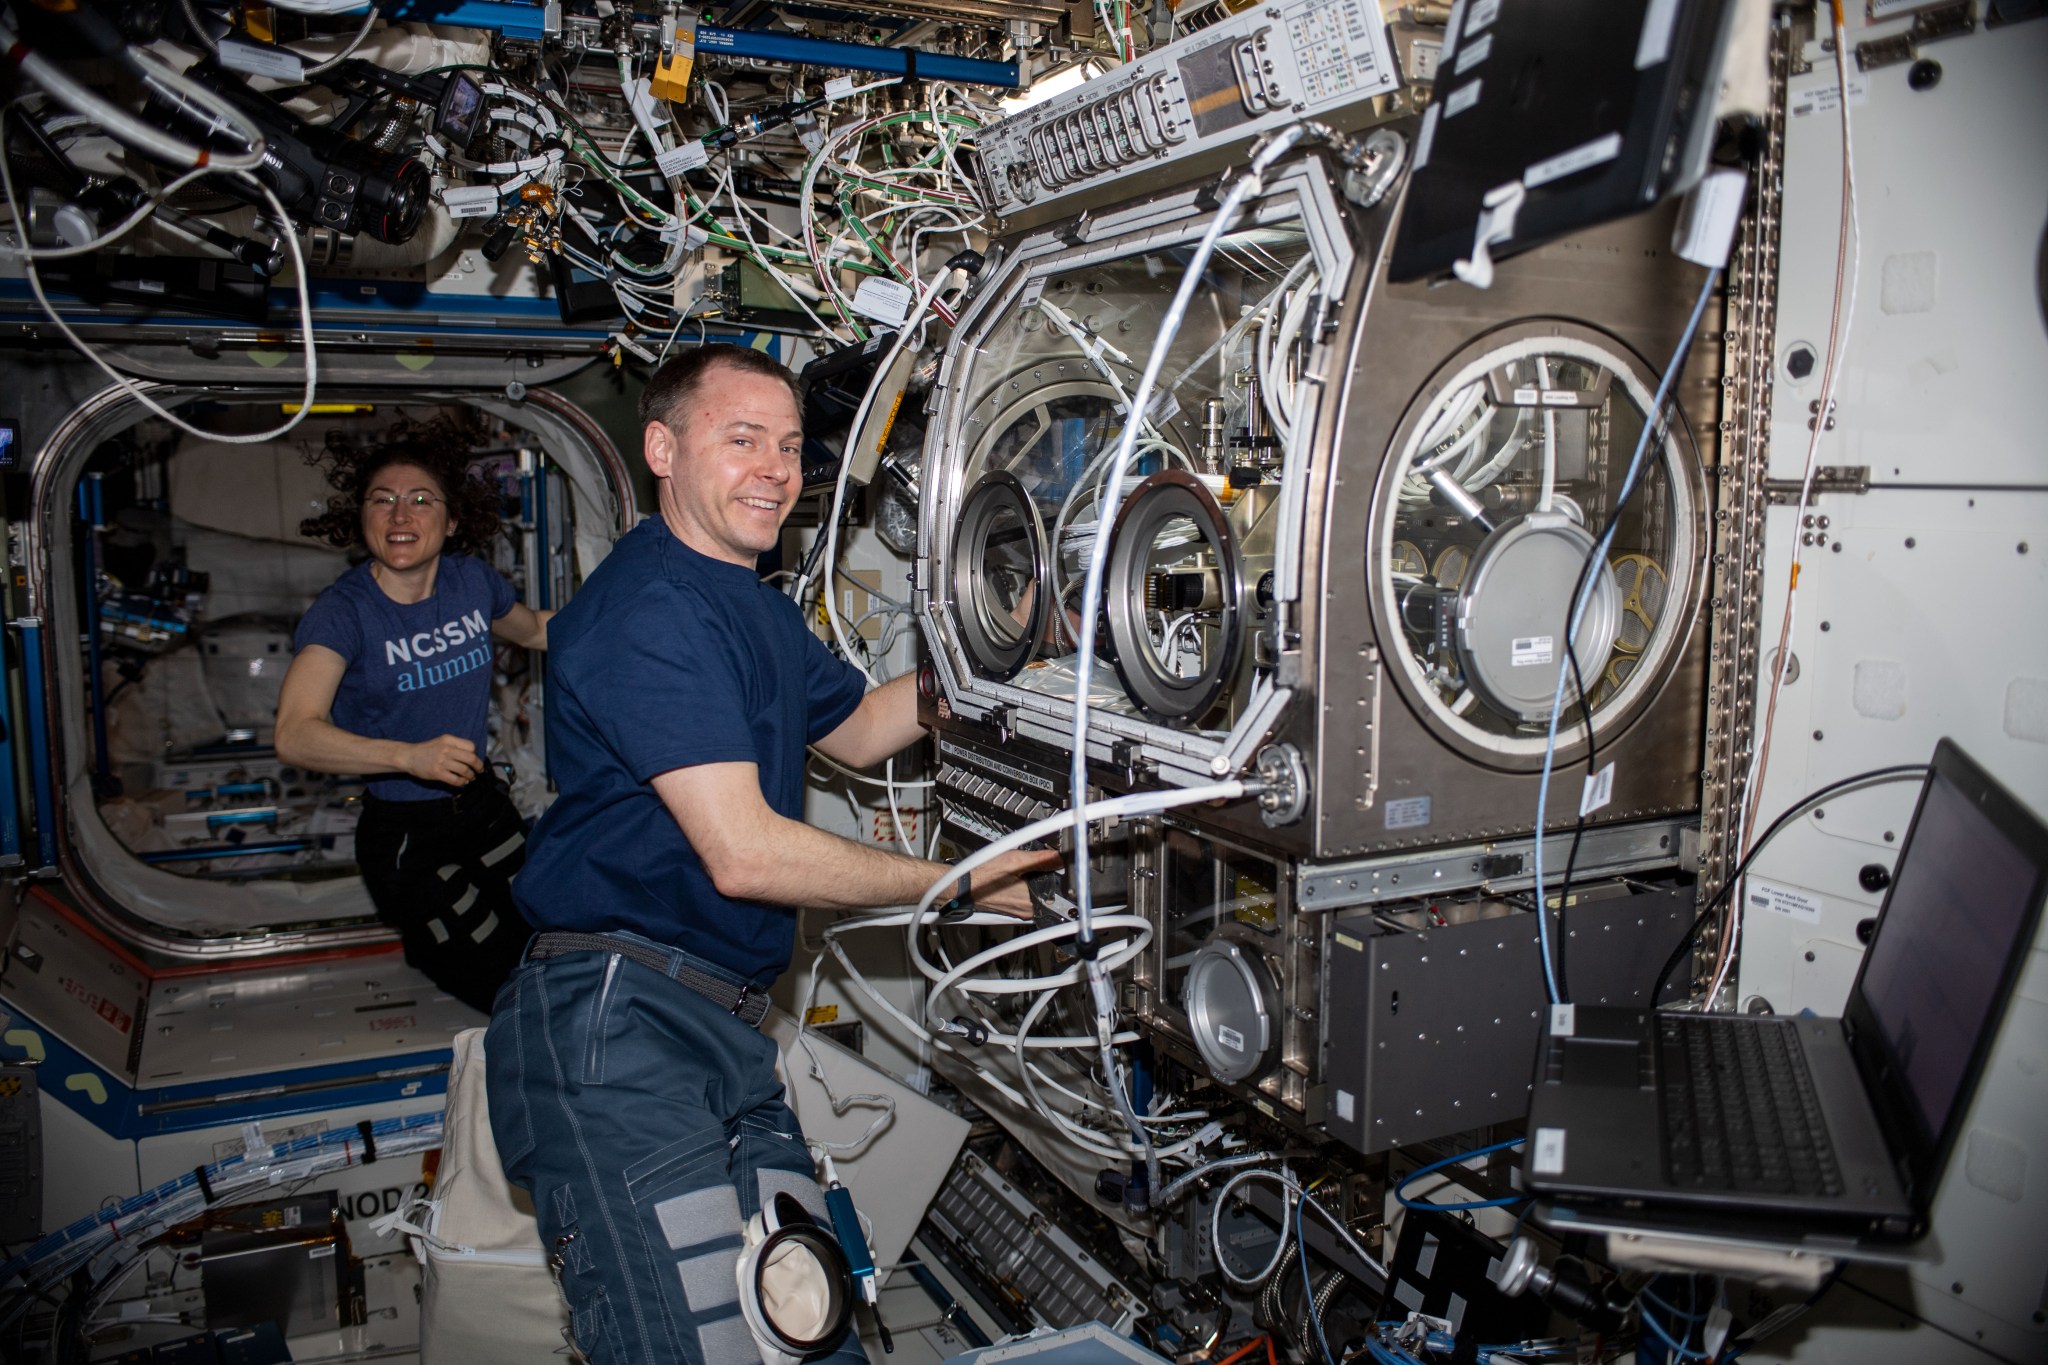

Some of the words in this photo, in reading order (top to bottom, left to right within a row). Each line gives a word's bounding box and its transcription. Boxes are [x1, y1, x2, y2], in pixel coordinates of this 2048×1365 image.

[976, 123, 995, 138] COMMAND
[1003, 109, 1028, 126] MONITORING
[1028, 105, 1040, 118] PANEL
[385, 609, 489, 666] NCSSM
[397, 636, 492, 692] alumni
[953, 746, 968, 759] POWER
[967, 750, 993, 767] DISTRIBUTION
[993, 759, 1002, 770] AND
[1002, 762, 1028, 781] CONVERSION
[1029, 774, 1039, 785] BOX
[1771, 889, 1784, 897] Lower
[1797, 896, 1808, 904] Door
